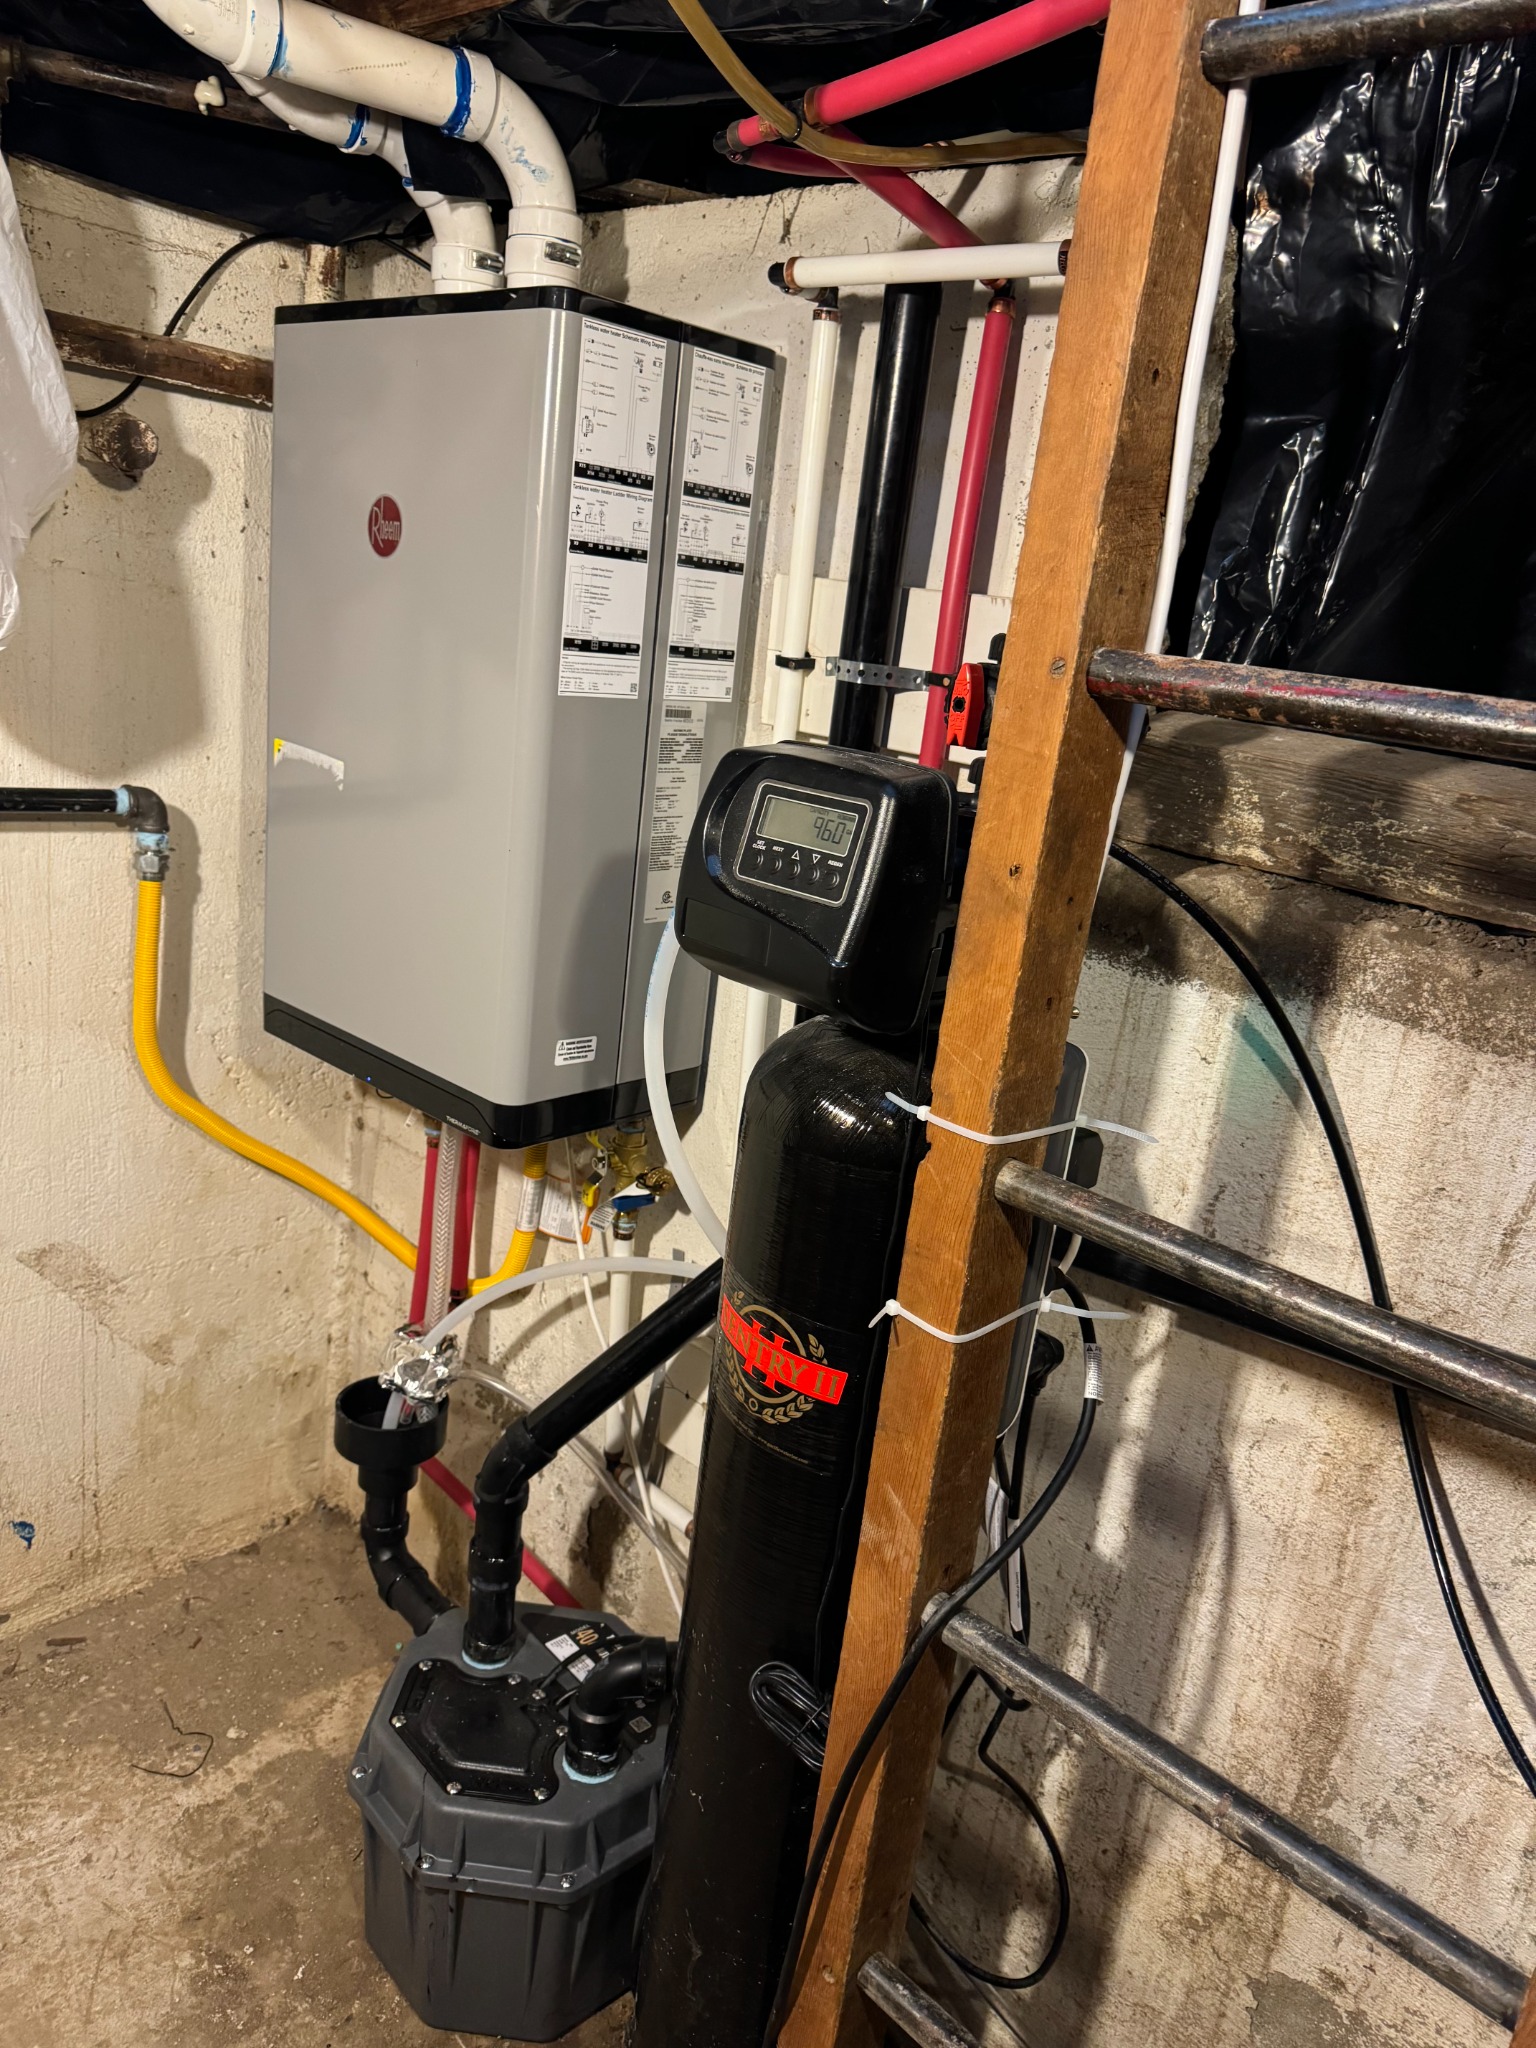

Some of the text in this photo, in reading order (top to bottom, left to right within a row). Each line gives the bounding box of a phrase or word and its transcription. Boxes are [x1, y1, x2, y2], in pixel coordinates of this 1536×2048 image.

[622, 334, 639, 343] Schematic
[573, 484, 589, 492] Tankless
[372, 496, 400, 548] Rheem
[814, 816, 846, 844] 960
[722, 1303, 840, 1398] SENTRY II
